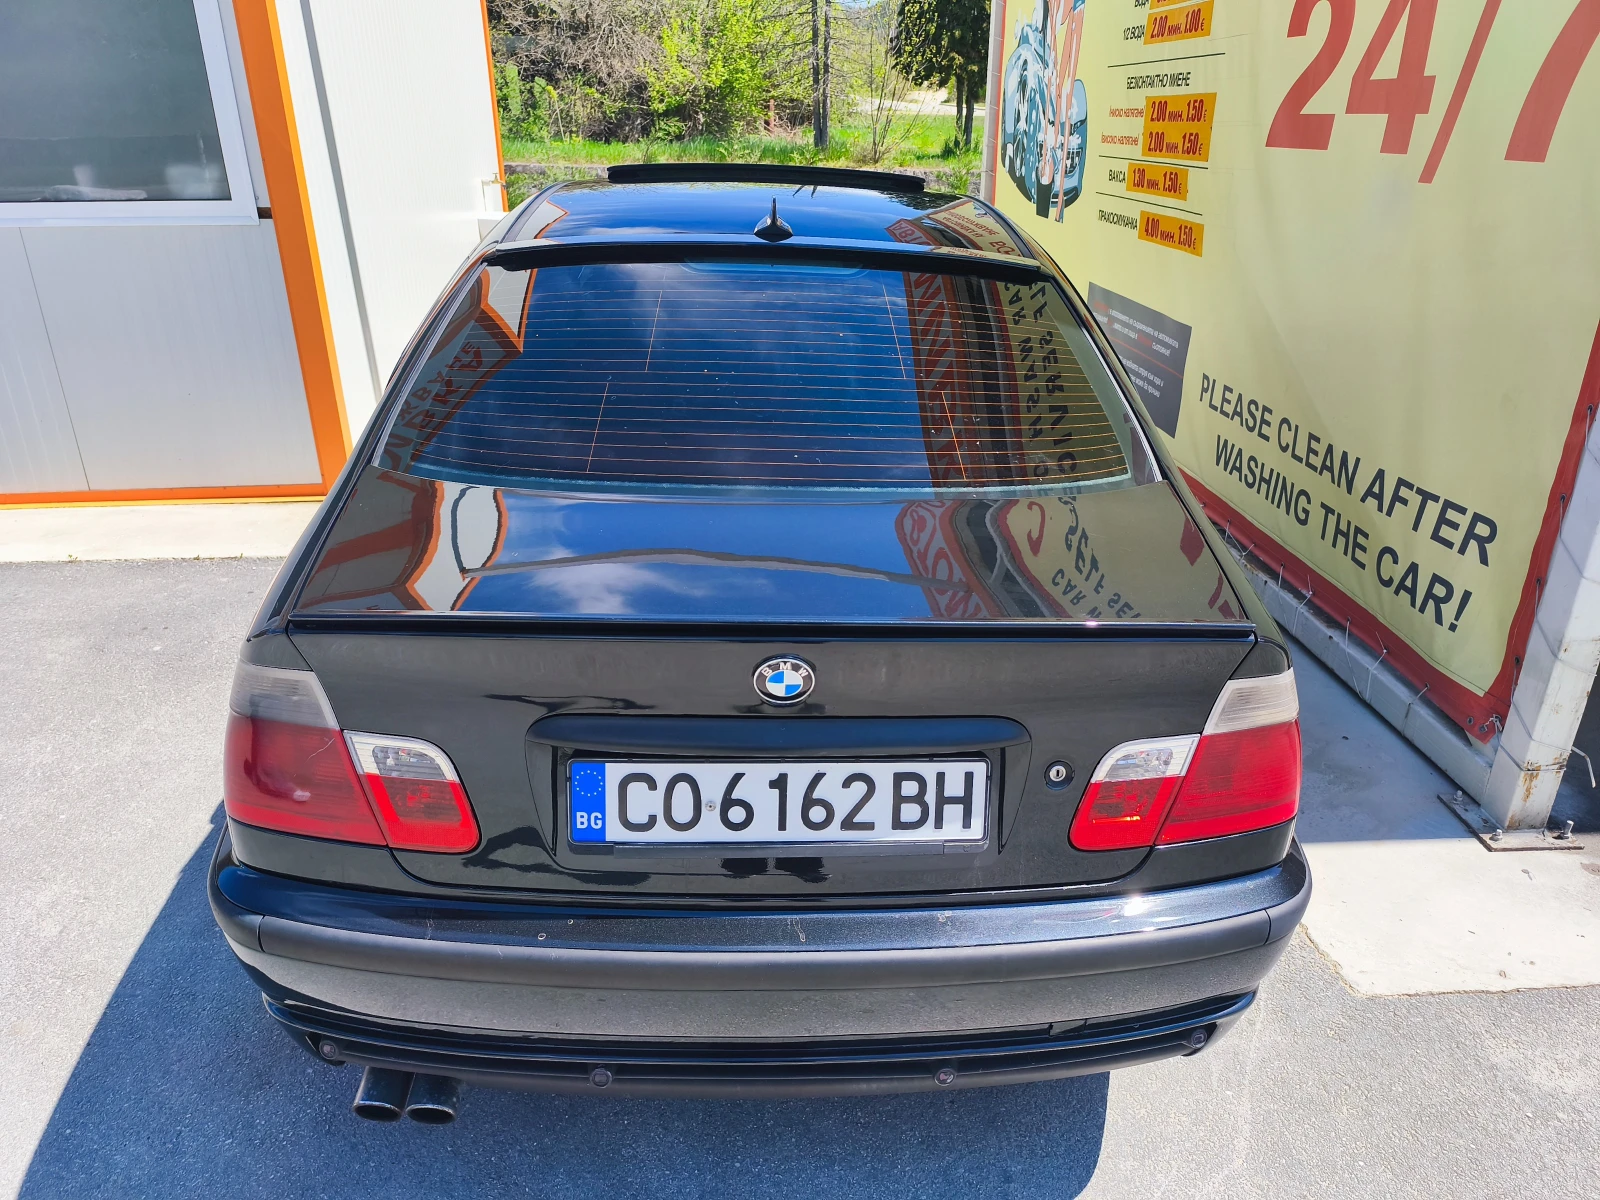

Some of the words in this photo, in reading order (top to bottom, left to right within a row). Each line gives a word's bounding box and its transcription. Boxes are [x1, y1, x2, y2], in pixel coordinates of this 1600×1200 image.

[1150, 15, 1168, 39] 2.00
[1184, 8, 1202, 34] 1.00
[1150, 100, 1168, 122] 2.00
[1186, 99, 1204, 122] 1.50
[1147, 131, 1165, 153] 2.00
[1181, 132, 1199, 156] 1.50
[1108, 169, 1126, 184] ВАКСА
[1132, 168, 1146, 188] 1.30
[1162, 170, 1179, 194] 1.50
[1144, 216, 1160, 239] 4.00
[1178, 224, 1193, 249] 1.50
[1200, 372, 1273, 443] PLEASE
[1277, 417, 1361, 496] CLEAN
[1359, 468, 1498, 568] AFTER
[1215, 434, 1312, 526] WASHING
[1319, 501, 1370, 571] THE
[1376, 545, 1473, 633] CAR!
[719, 772, 876, 832] 6162
[575, 812, 603, 830] BG
